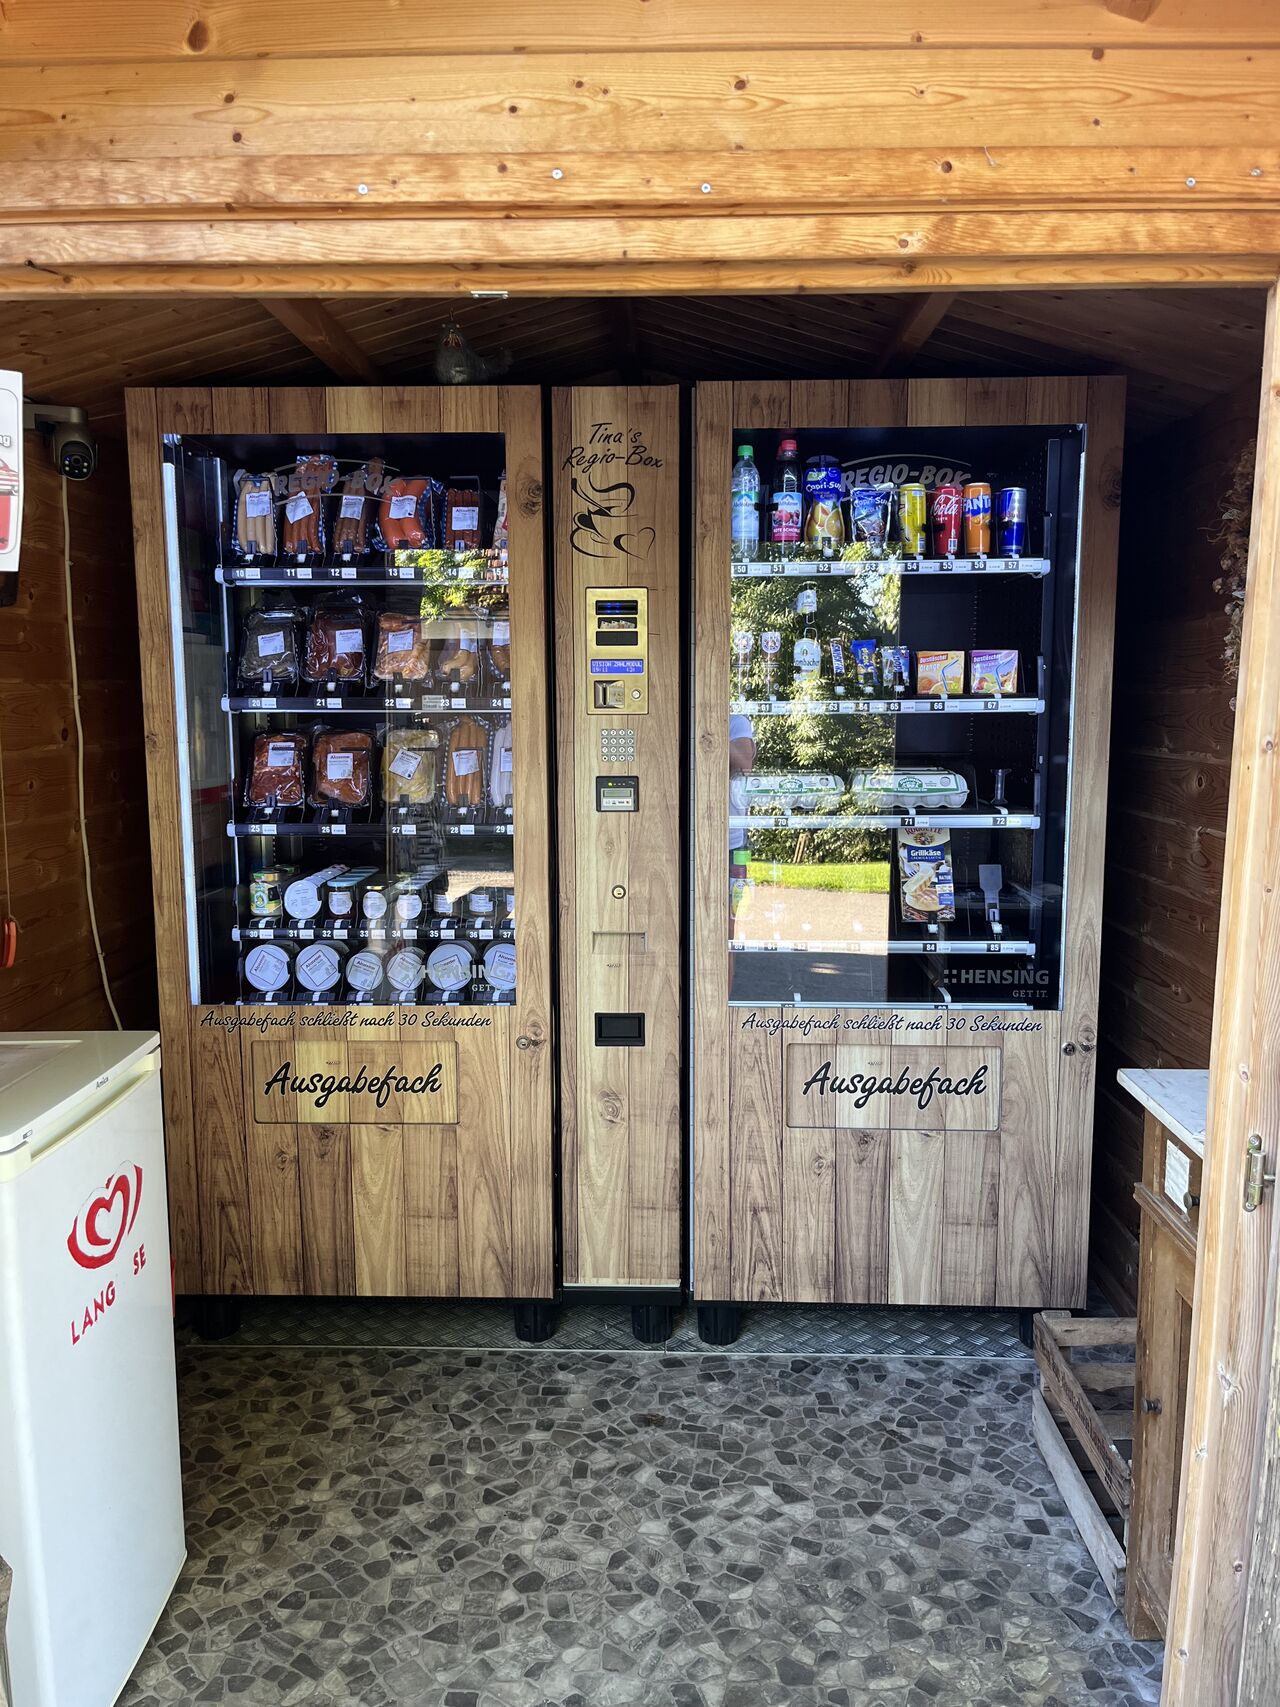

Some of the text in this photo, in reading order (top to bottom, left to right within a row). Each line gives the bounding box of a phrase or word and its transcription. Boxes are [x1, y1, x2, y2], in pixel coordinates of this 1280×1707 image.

[589, 422, 643, 445] Tina's
[561, 445, 664, 474] Regio-Box
[907, 562, 917, 570] 54
[974, 561, 984, 569] 56
[1008, 561, 1017, 569] 57
[910, 849, 941, 857] Grillkäse
[961, 969, 1049, 985] HENSING
[1012, 990, 1049, 998] GET IT.
[200, 1010, 491, 1033] Ausgabefach schließt nach 30 Sekunden
[741, 1012, 1043, 1035] Ausgabefach schließt nach 30 Sekunden
[264, 1061, 443, 1109] Ausgabefach
[802, 1061, 988, 1110] Ausgabefach
[71, 1243, 146, 1346] LANG SE
